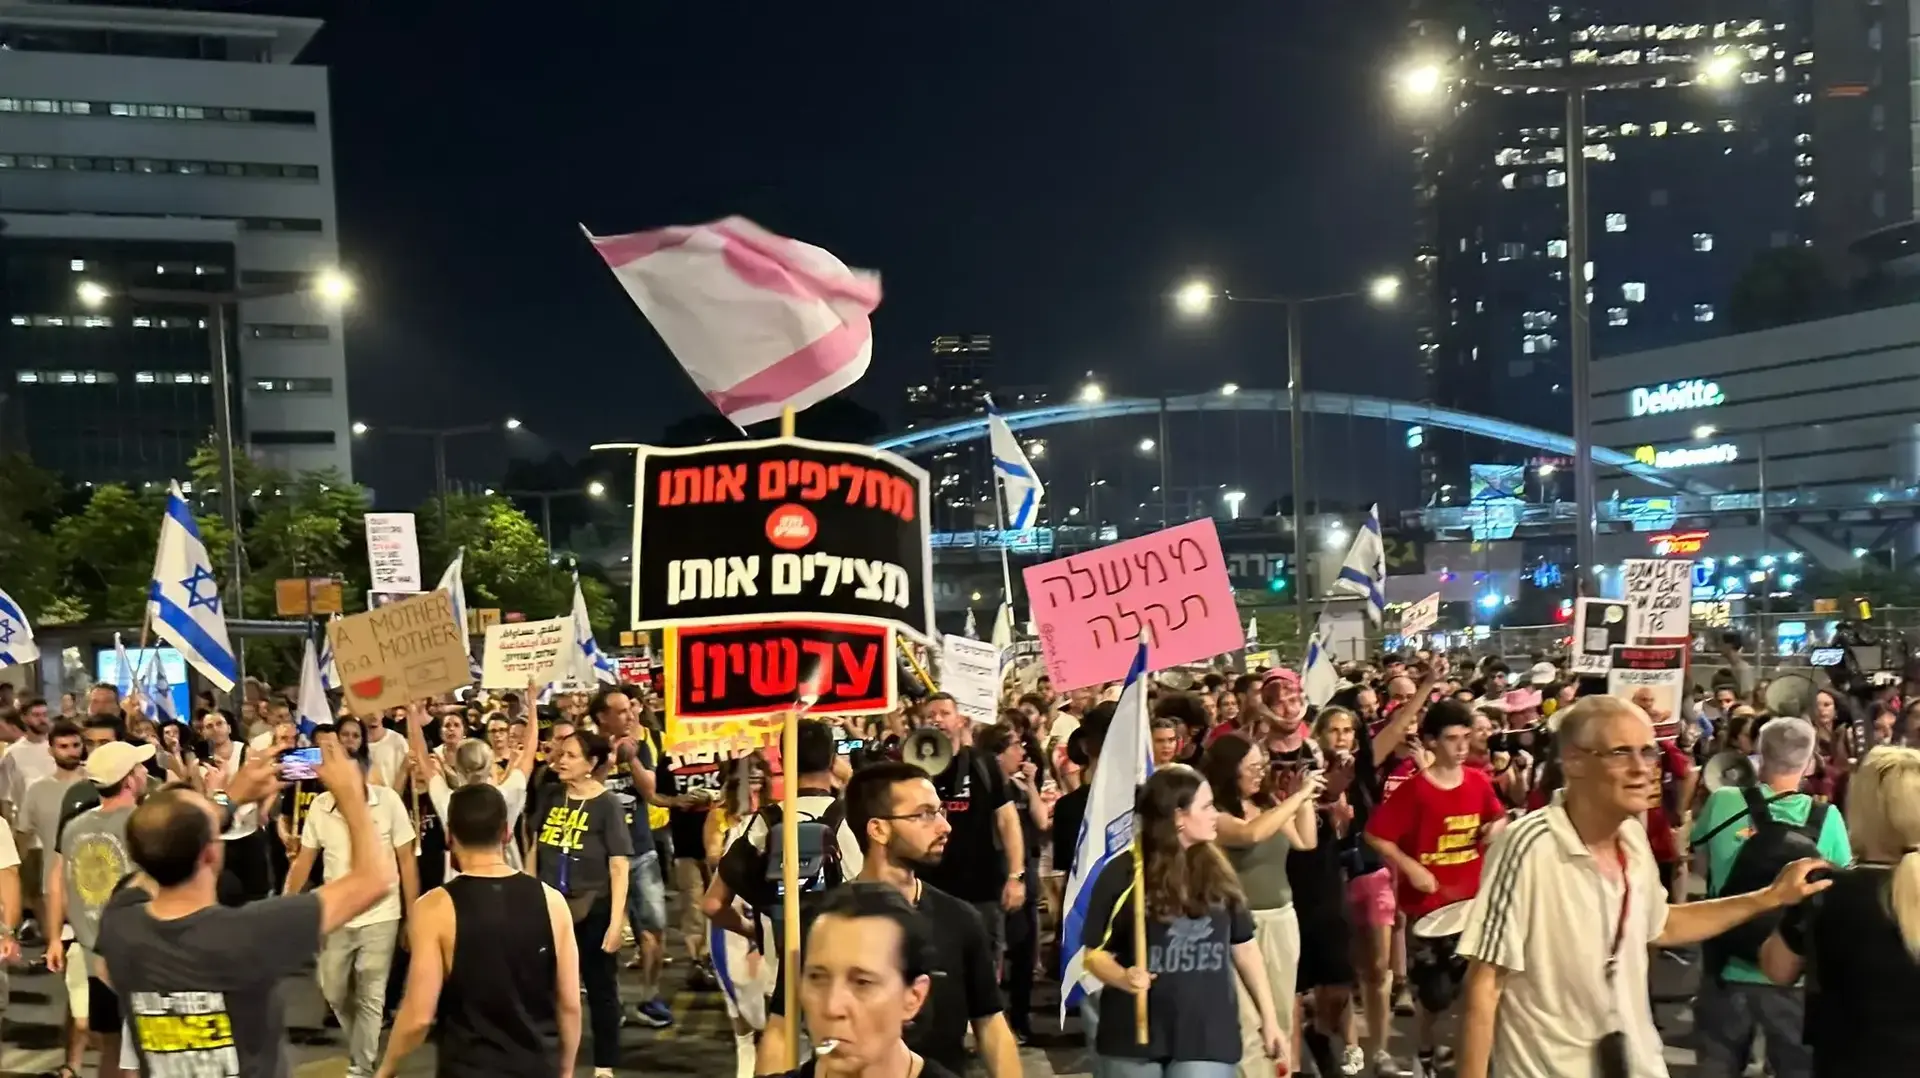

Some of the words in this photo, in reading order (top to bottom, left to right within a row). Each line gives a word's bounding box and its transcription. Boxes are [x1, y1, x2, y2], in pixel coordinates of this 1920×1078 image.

[657, 462, 748, 507] אותו
[758, 460, 914, 522] מחליפים
[771, 552, 910, 609] מצילים
[336, 626, 353, 649] A
[369, 596, 451, 642] MOTHER
[378, 623, 459, 663] MOTHER
[1086, 594, 1209, 650] תקלה
[690, 636, 878, 703] עכשיו!
[546, 807, 589, 832] SEAL
[1149, 942, 1224, 973] ROSES
